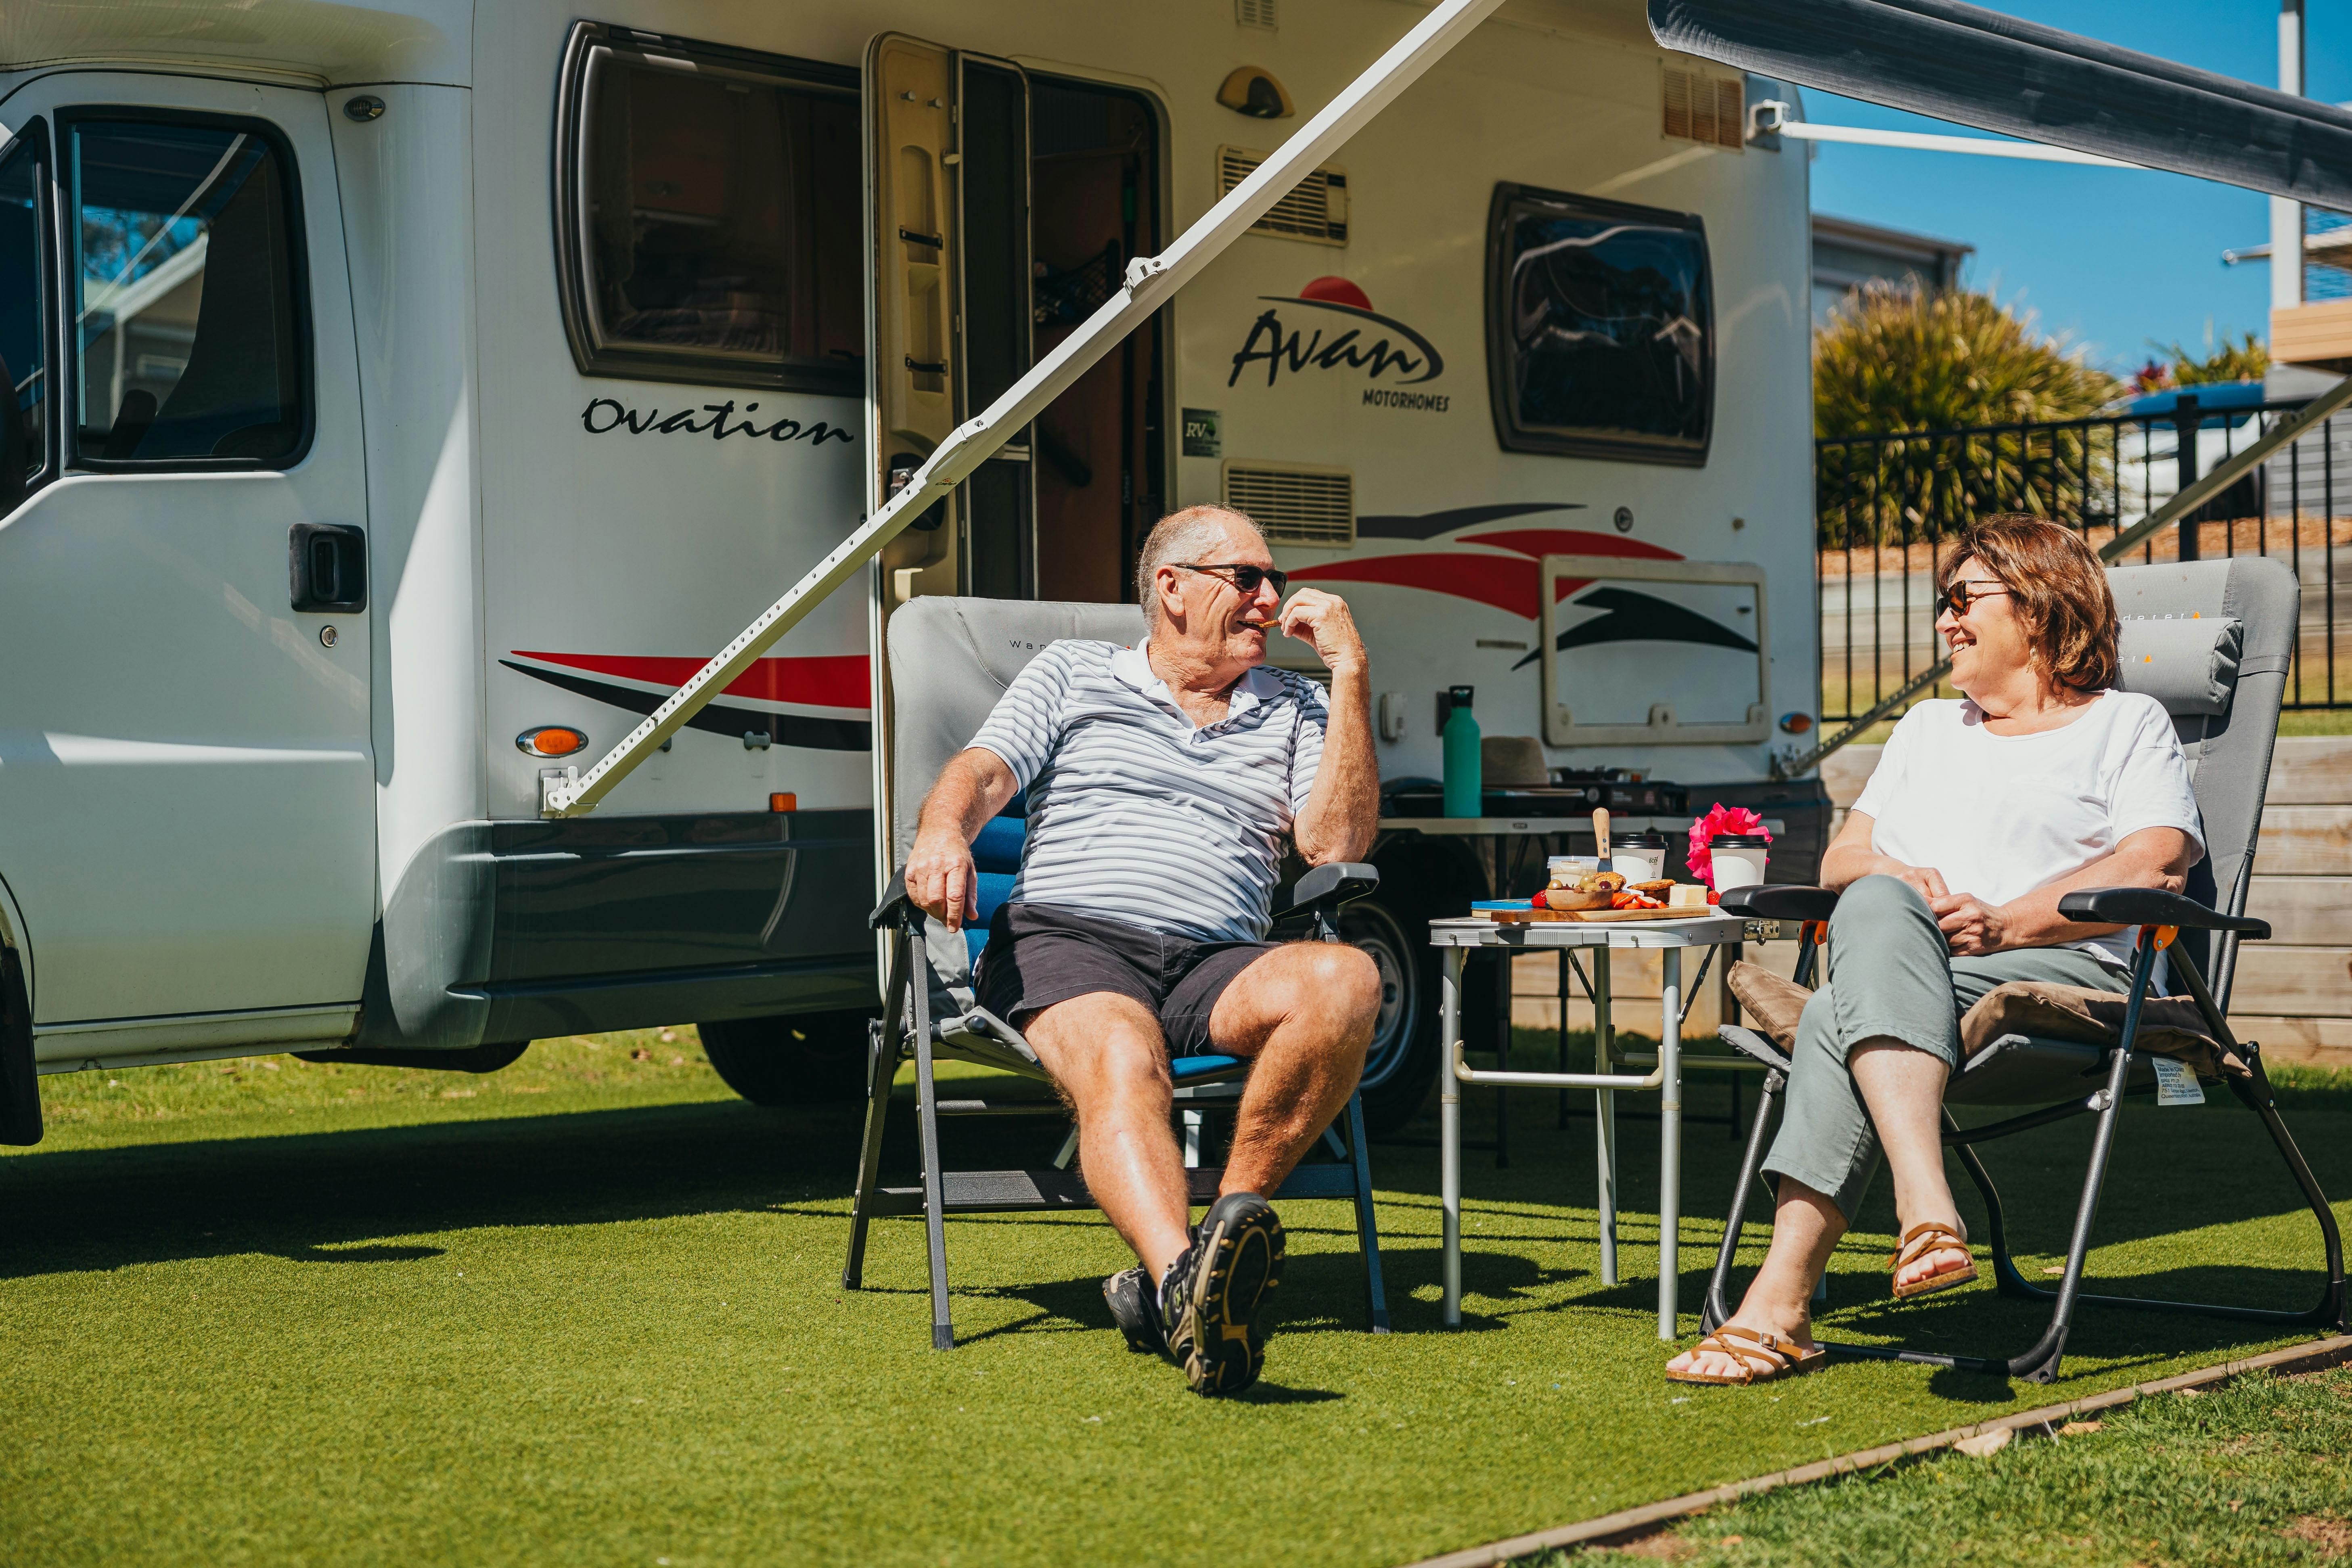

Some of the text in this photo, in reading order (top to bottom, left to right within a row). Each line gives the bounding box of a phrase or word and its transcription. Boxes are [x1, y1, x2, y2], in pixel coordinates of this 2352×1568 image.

[1228, 309, 1422, 387] Avan
[1363, 389, 1450, 412] MOTORHOMES
[581, 398, 854, 446] Ovation
[1185, 422, 1207, 438] RV
